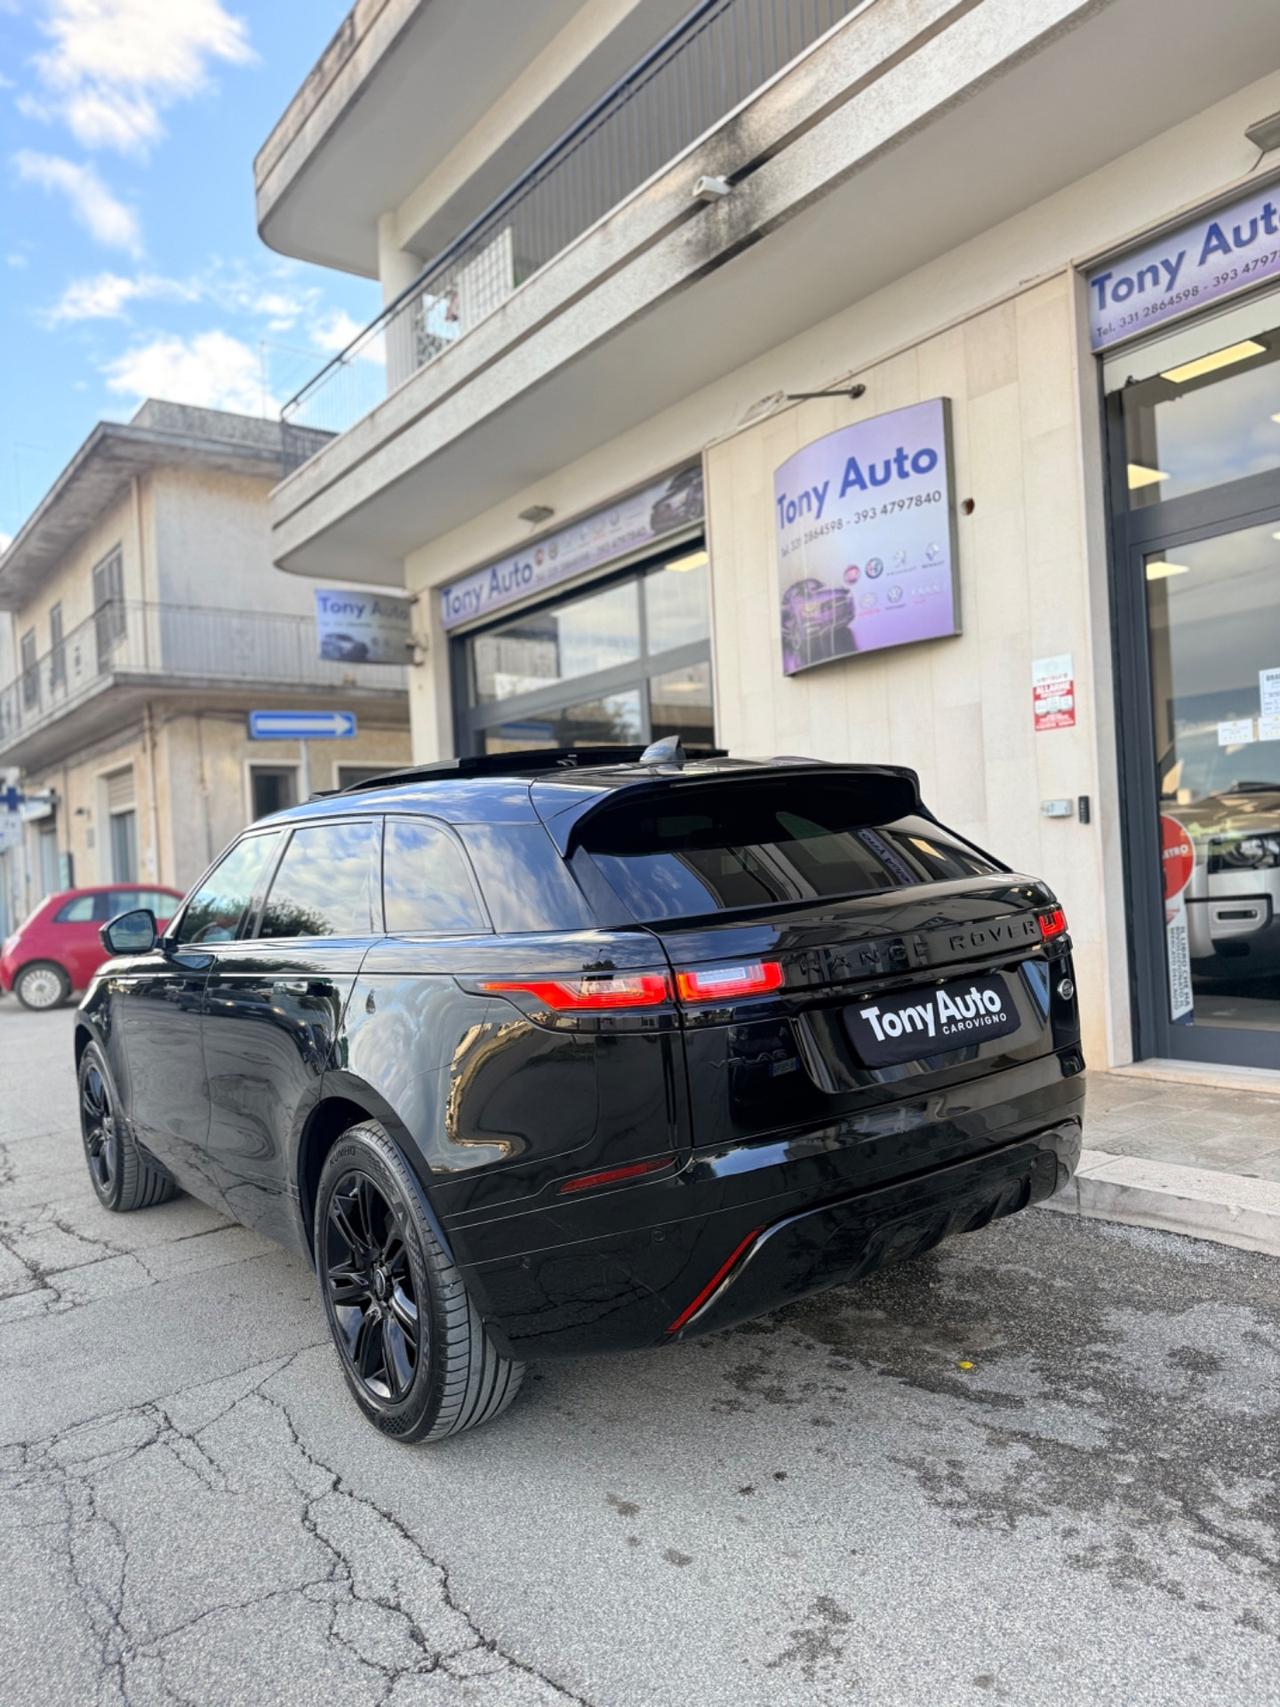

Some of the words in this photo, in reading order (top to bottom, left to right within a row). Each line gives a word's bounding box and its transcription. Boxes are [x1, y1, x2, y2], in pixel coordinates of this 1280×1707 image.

[1091, 250, 1187, 311] Tony
[1198, 201, 1280, 267] Aut
[1096, 324, 1116, 338] Tel.
[1119, 312, 1140, 329] 331
[1143, 285, 1200, 319] 2864598
[1212, 269, 1238, 288] 393
[1242, 250, 1280, 275] 4797
[777, 480, 830, 530] Tony
[838, 446, 939, 499] Auto
[853, 507, 877, 525] 393
[880, 489, 942, 516] 4797840
[319, 596, 366, 620] Tony
[443, 585, 485, 619] Tony
[488, 561, 534, 601] Auto
[799, 939, 929, 973] RANGE
[949, 920, 1037, 951] ROVER
[942, 1012, 1007, 1035] CAROVIGNO
